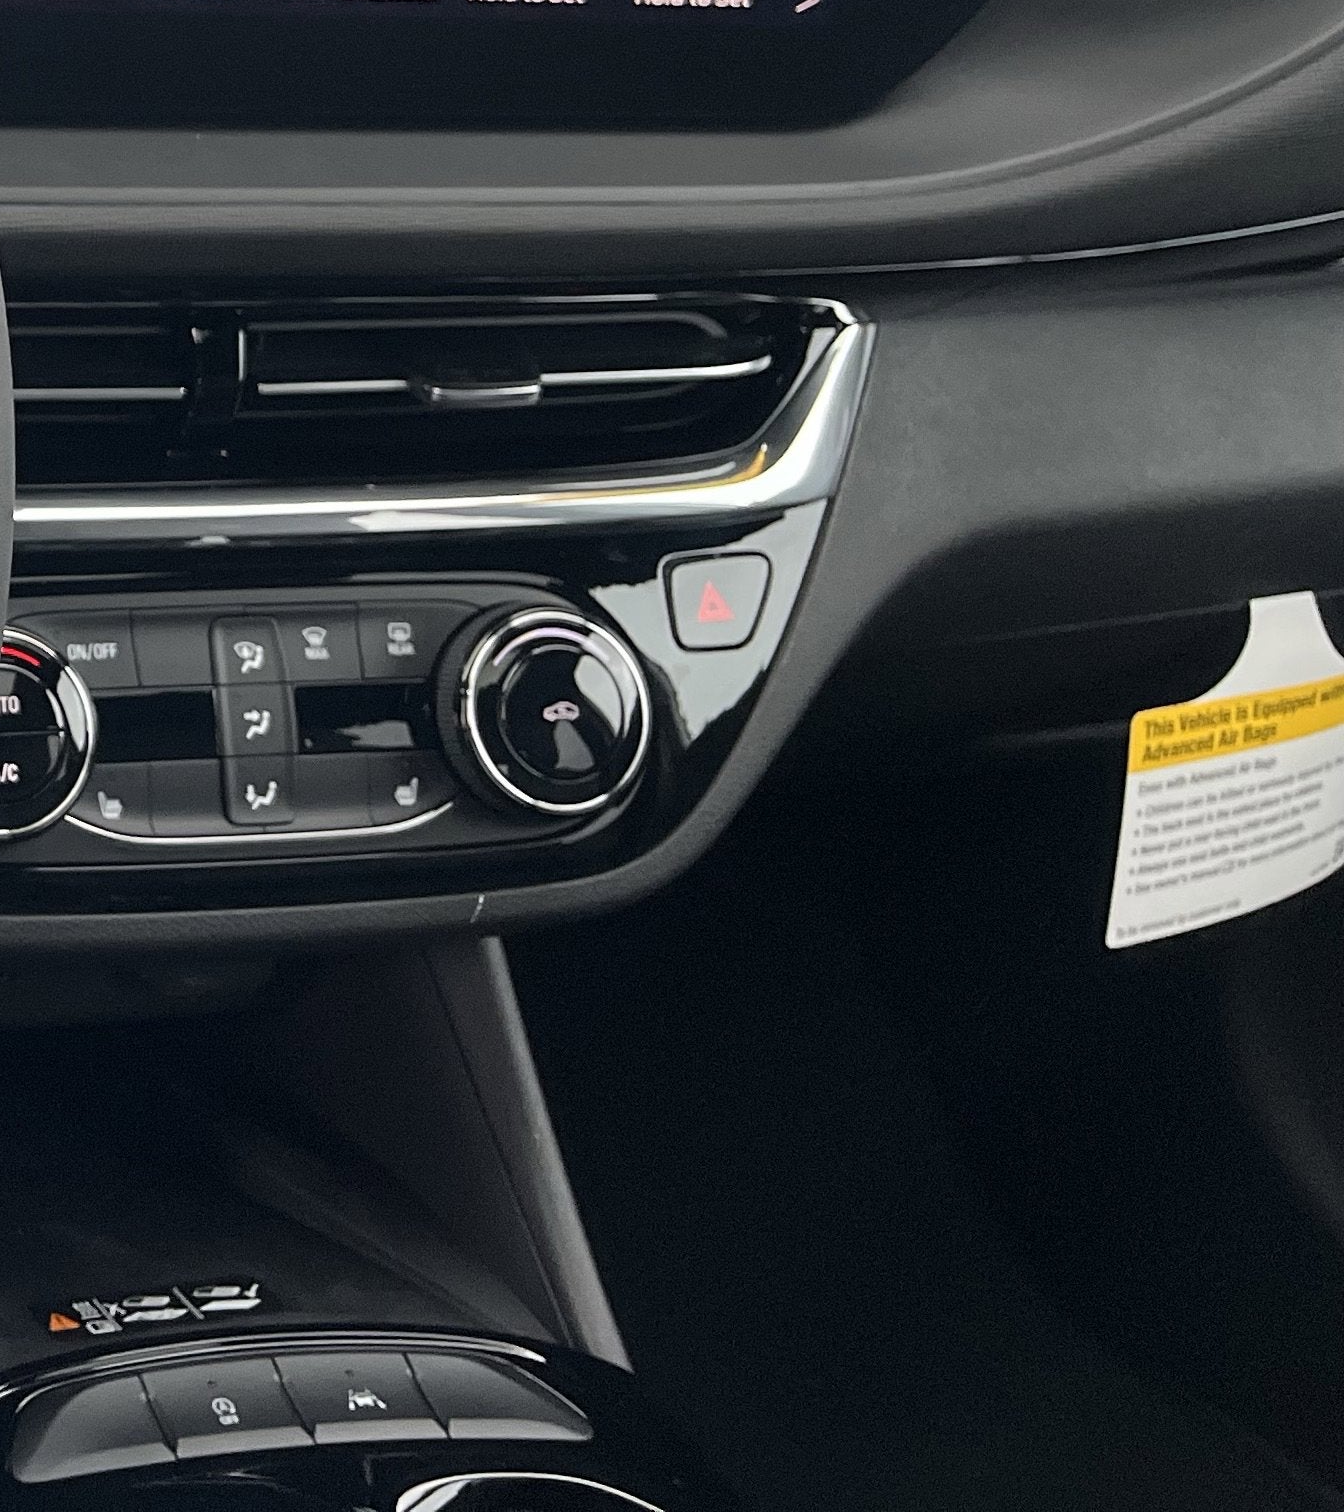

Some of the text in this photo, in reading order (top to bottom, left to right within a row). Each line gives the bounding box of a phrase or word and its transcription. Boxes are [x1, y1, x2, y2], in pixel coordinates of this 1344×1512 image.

[66, 642, 118, 661] ON/OFF
[1144, 718, 1174, 738] This
[1180, 709, 1231, 731] Vehicle
[1142, 734, 1214, 763] Advanced
